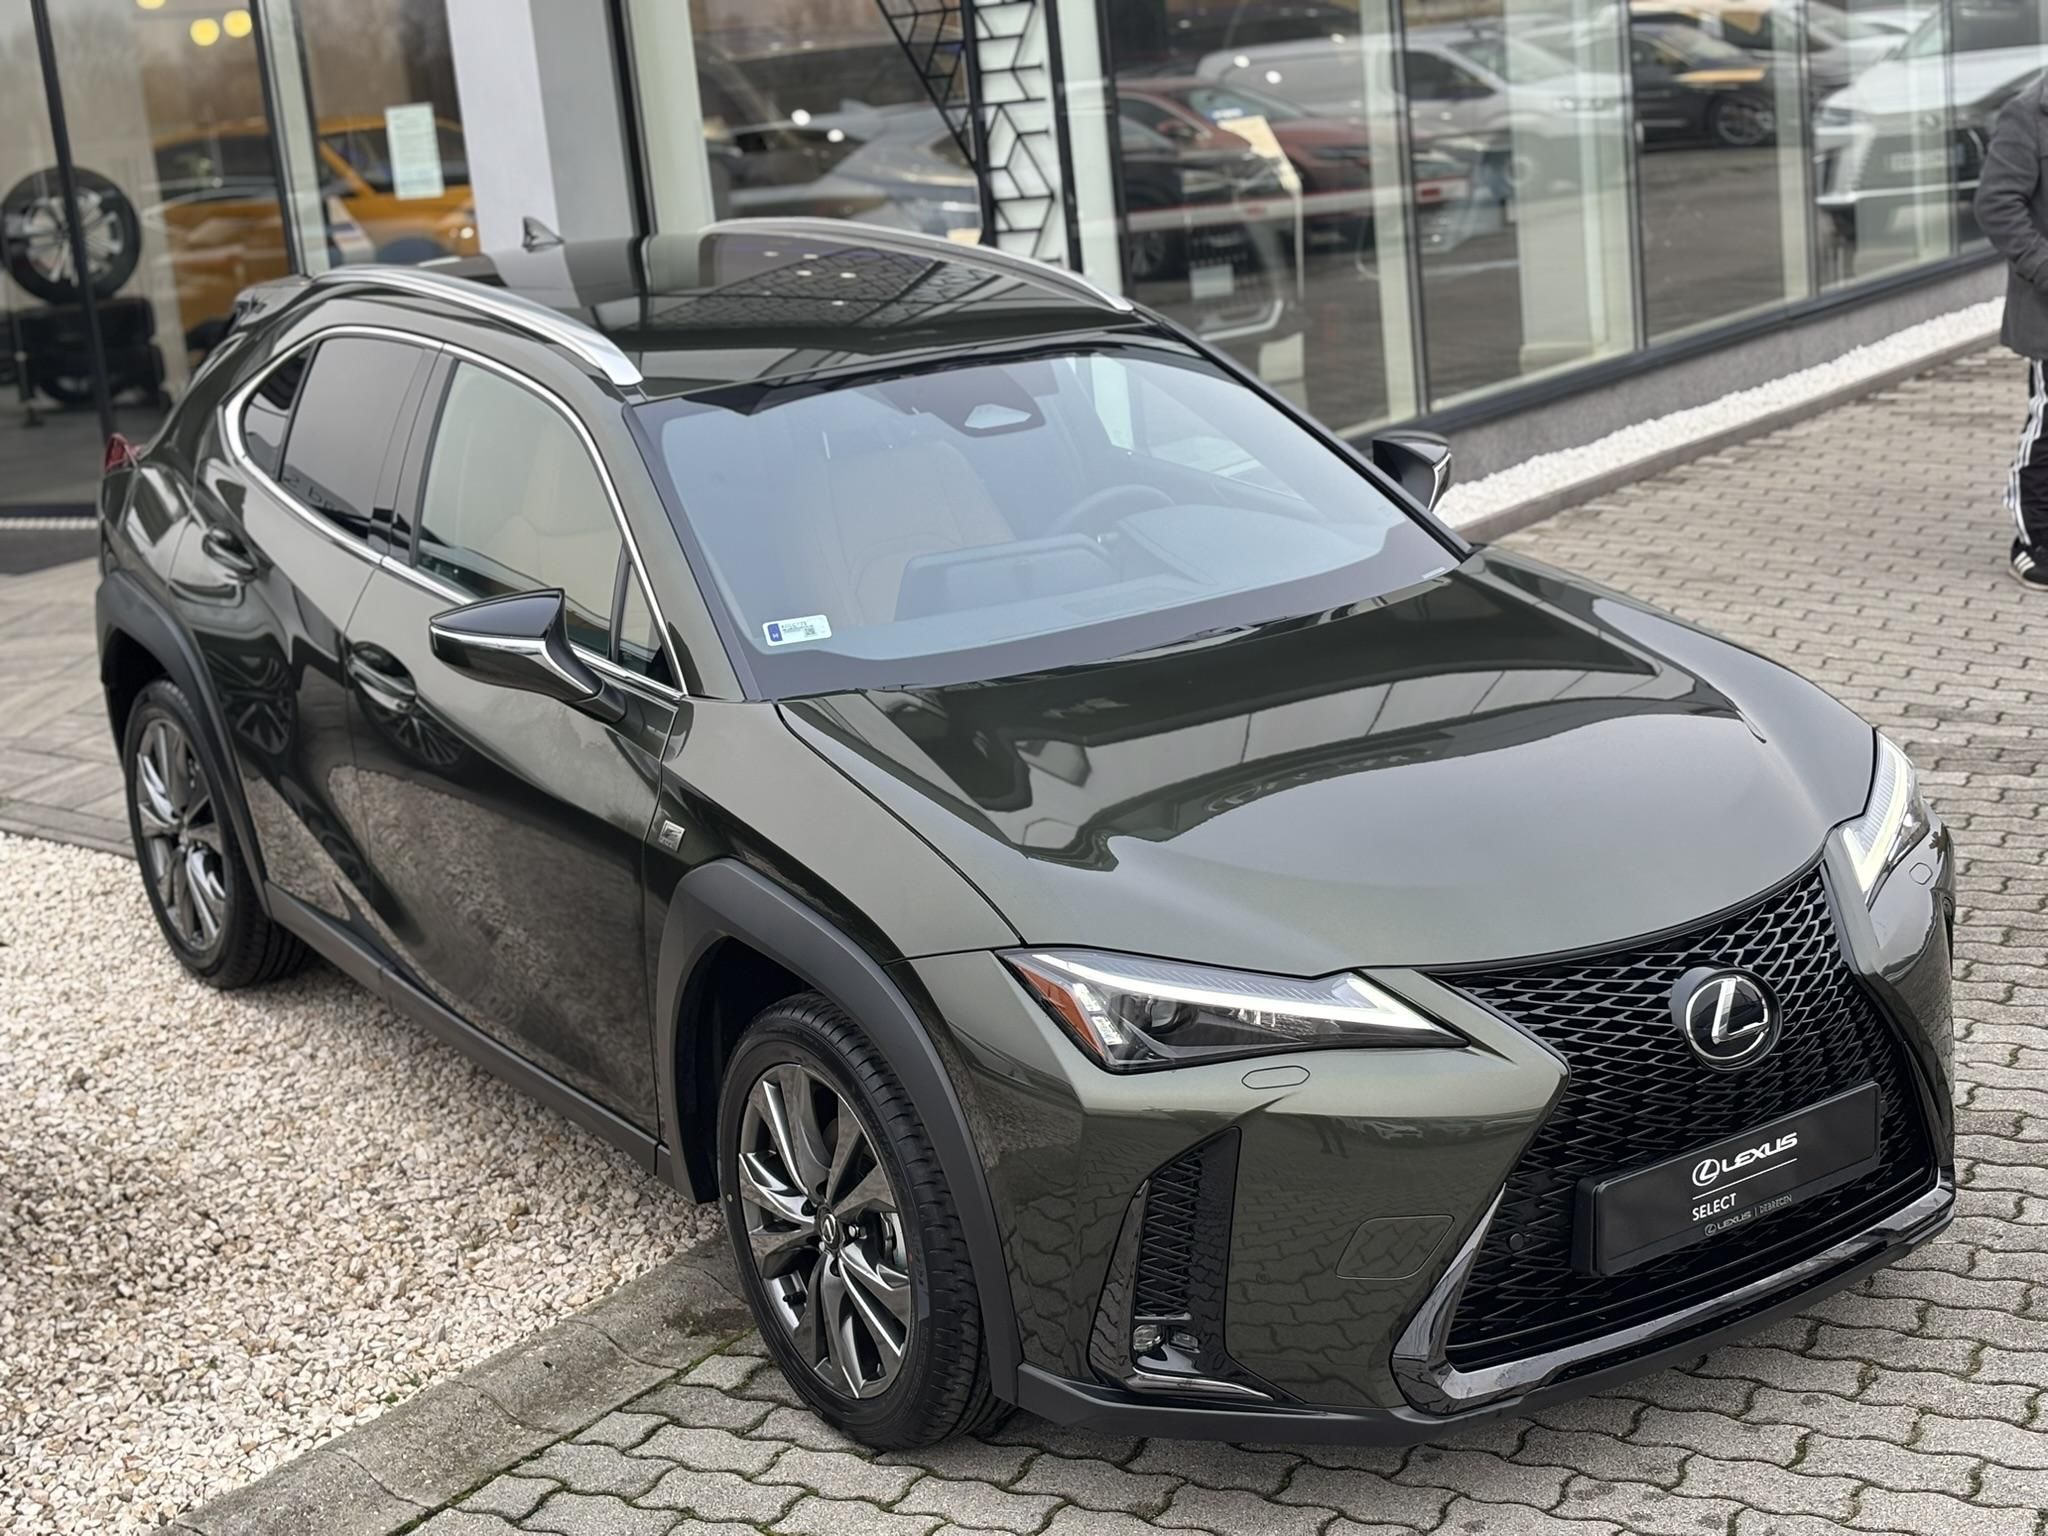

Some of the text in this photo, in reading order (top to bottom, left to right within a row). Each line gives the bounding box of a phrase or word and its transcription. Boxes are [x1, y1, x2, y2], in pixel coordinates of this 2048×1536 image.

[1722, 1132, 1798, 1172] LEXUS
[1692, 1193, 1737, 1221] SELECT
[1717, 1211, 1751, 1229] LEXUS
